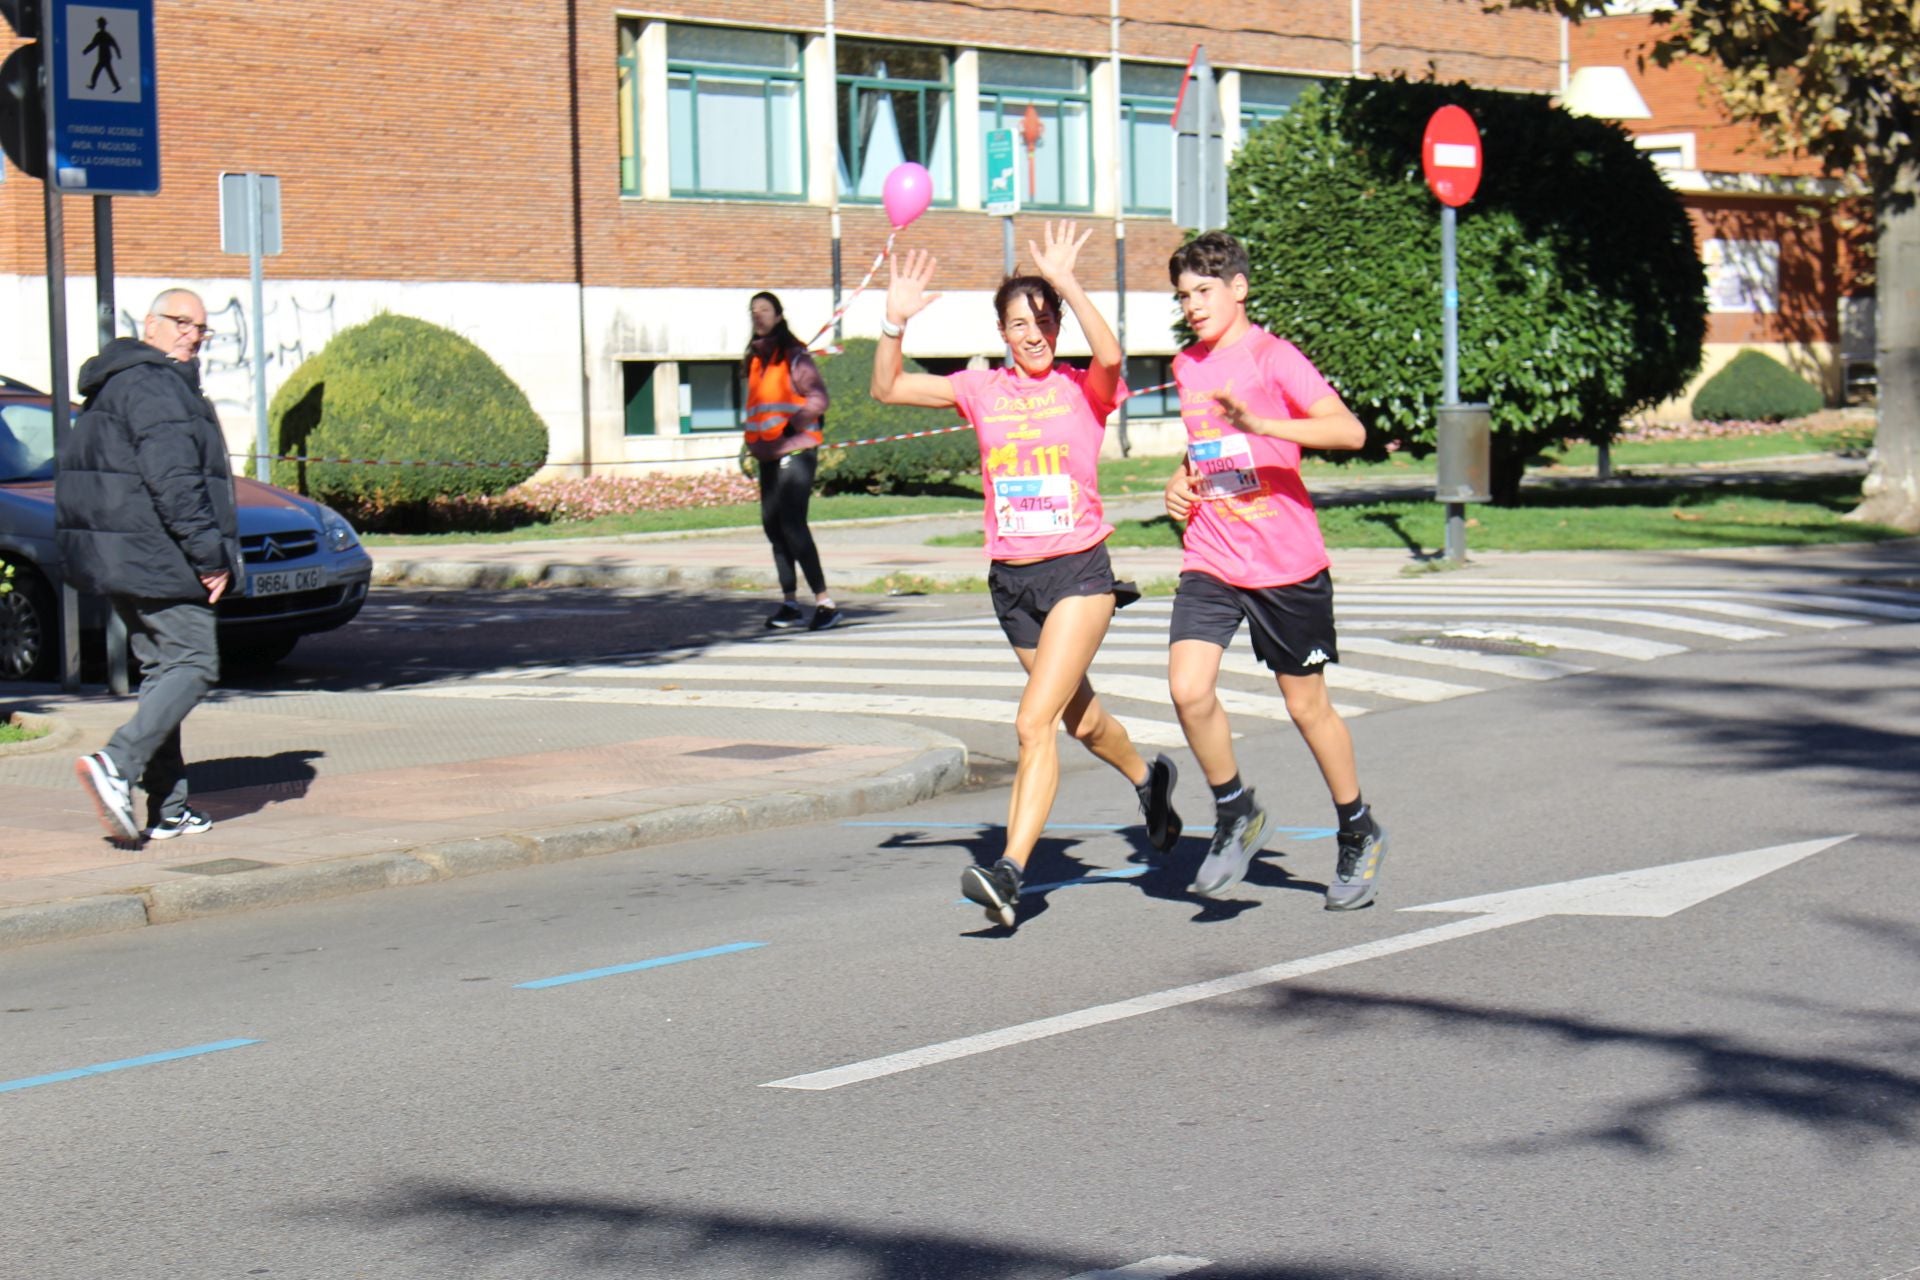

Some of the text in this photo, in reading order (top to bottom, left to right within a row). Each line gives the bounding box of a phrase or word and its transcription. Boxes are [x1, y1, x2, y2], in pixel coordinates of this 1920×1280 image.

[93, 156, 143, 167] CORREDERA
[1206, 457, 1234, 475] 1190
[1020, 496, 1053, 511] 4715
[256, 569, 318, 594] 9664 CKG
